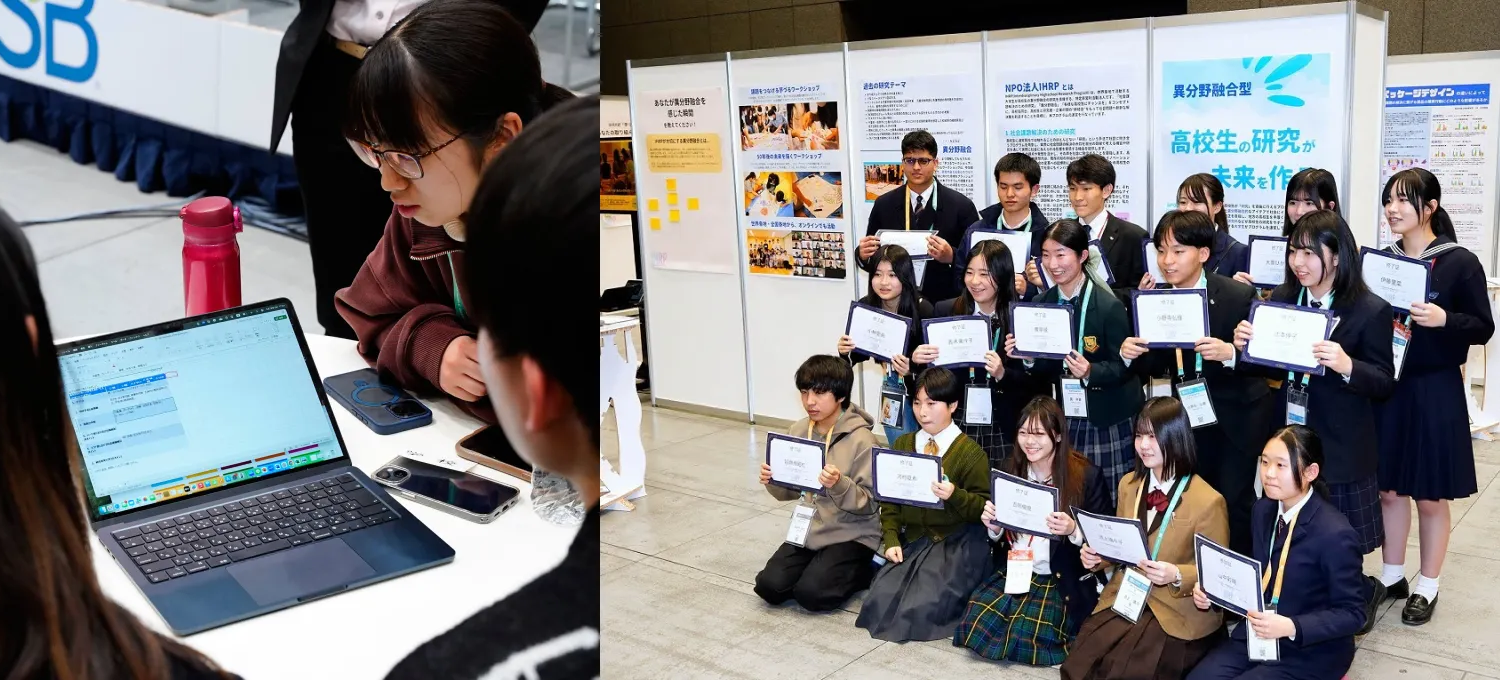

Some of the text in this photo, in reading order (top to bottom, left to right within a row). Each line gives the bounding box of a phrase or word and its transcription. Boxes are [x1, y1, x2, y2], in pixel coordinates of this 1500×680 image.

[863, 81, 907, 90] 過去の研究テーマ
[1005, 81, 1075, 92] NPO法人IHRP とは
[1173, 81, 1252, 98] 異分野融合型
[667, 109, 694, 118] 感じた瞬間
[1010, 128, 1076, 137] 社会課題解決のための研究
[1171, 128, 1316, 154] 高校生の研究が
[1211, 165, 1312, 190] 未来を作
